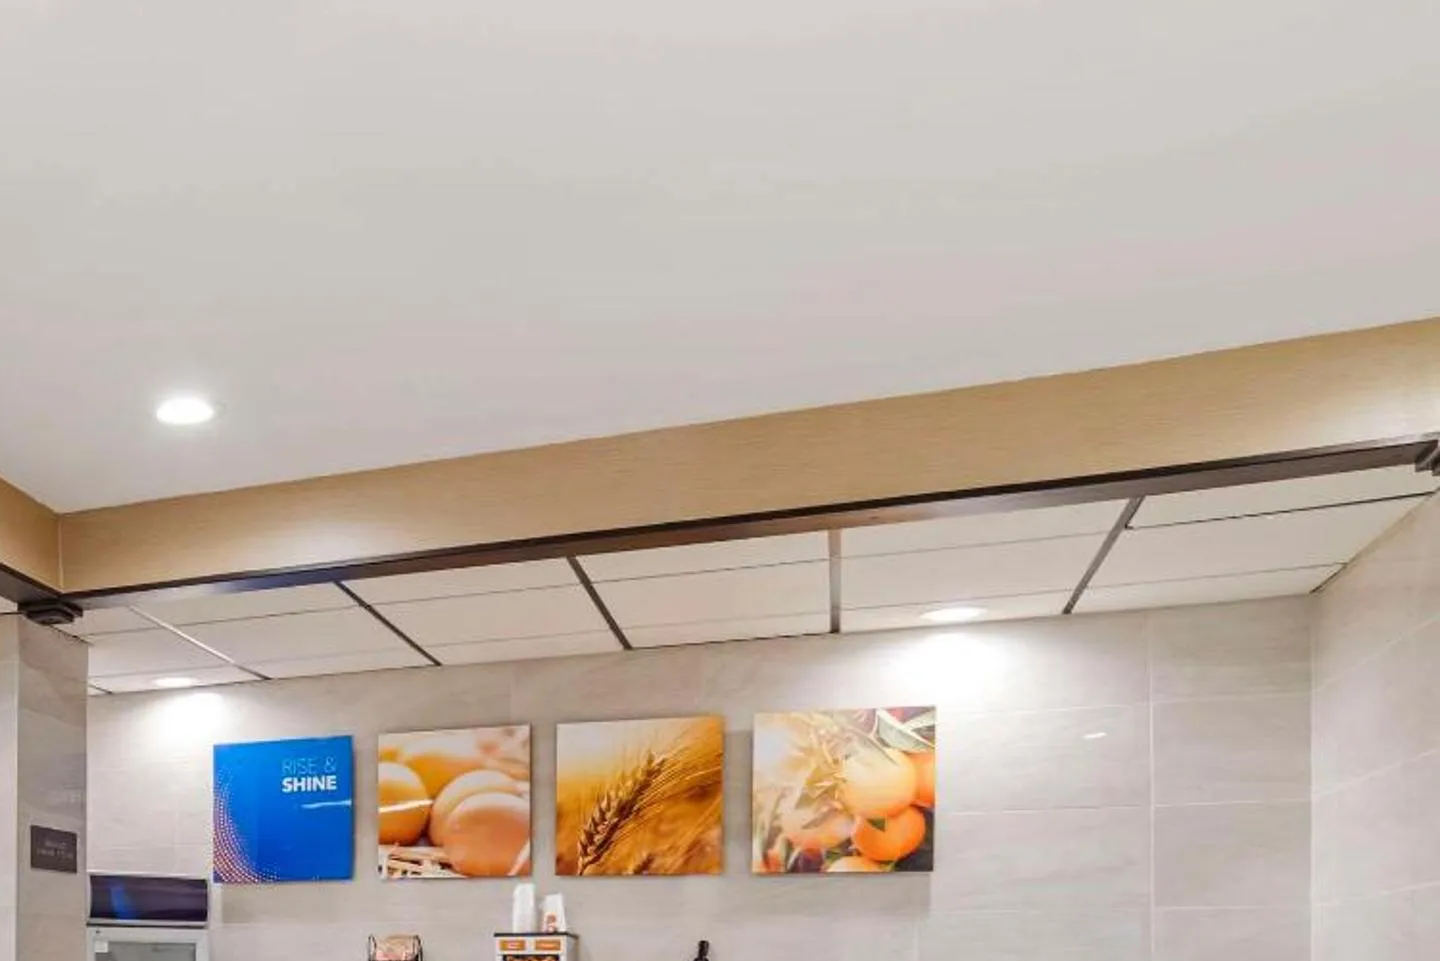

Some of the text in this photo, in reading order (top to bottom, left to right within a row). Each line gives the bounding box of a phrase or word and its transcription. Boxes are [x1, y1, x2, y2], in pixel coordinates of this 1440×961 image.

[281, 756, 336, 775] RISE &
[281, 775, 337, 793] SHINE
